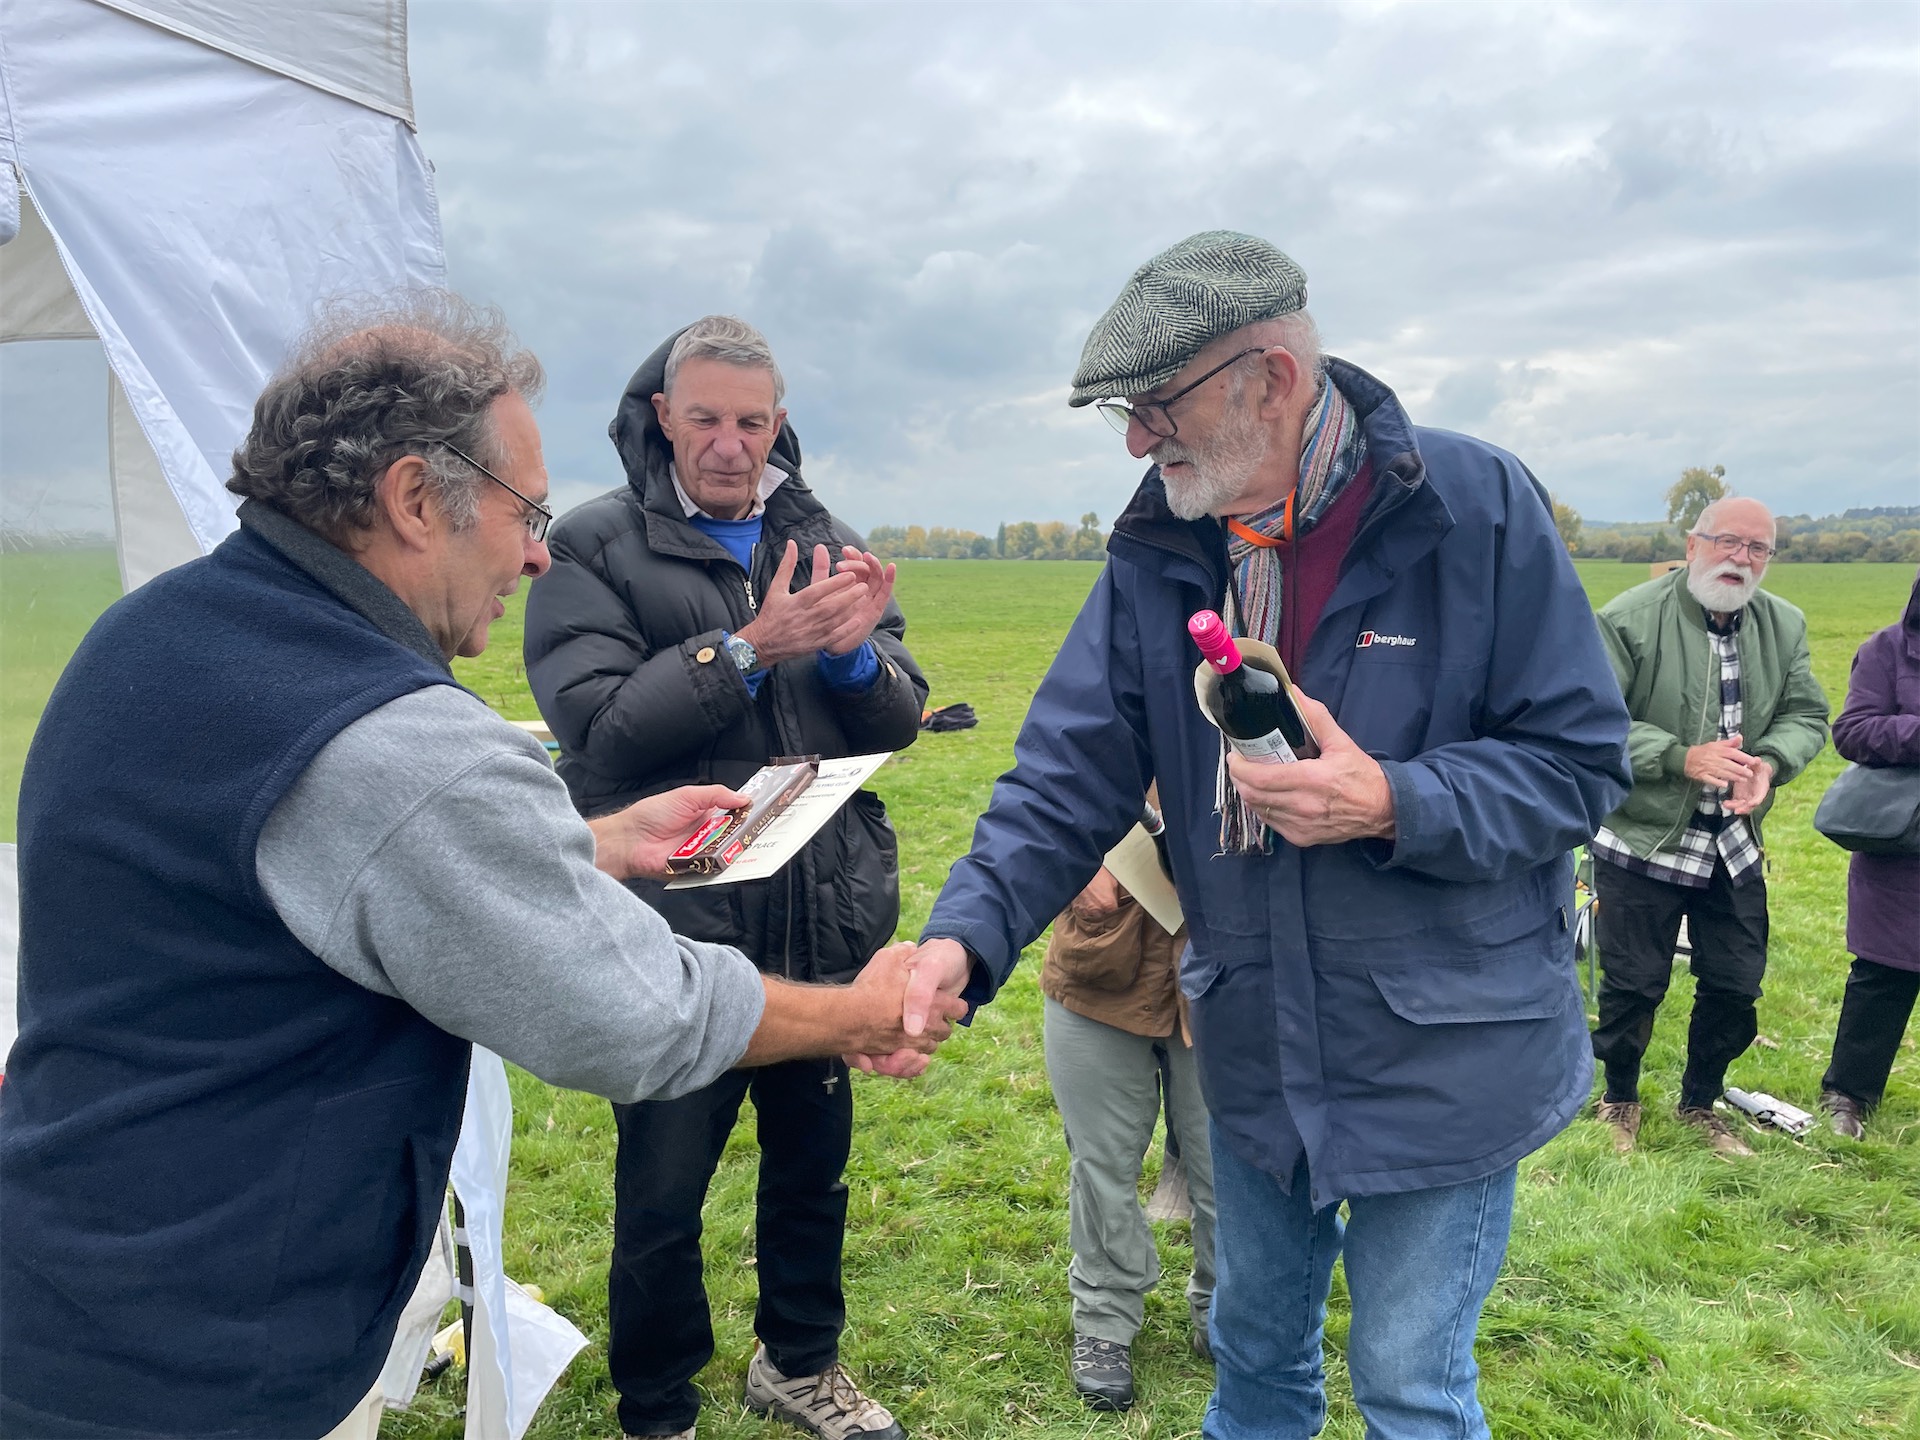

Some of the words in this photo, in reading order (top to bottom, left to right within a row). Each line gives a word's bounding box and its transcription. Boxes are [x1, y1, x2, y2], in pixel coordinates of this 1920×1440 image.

[1374, 633, 1417, 646] berghaus
[752, 808, 777, 833] CLASSIC
[704, 819, 742, 854] CLASSIC
[752, 840, 779, 849] PLACE
